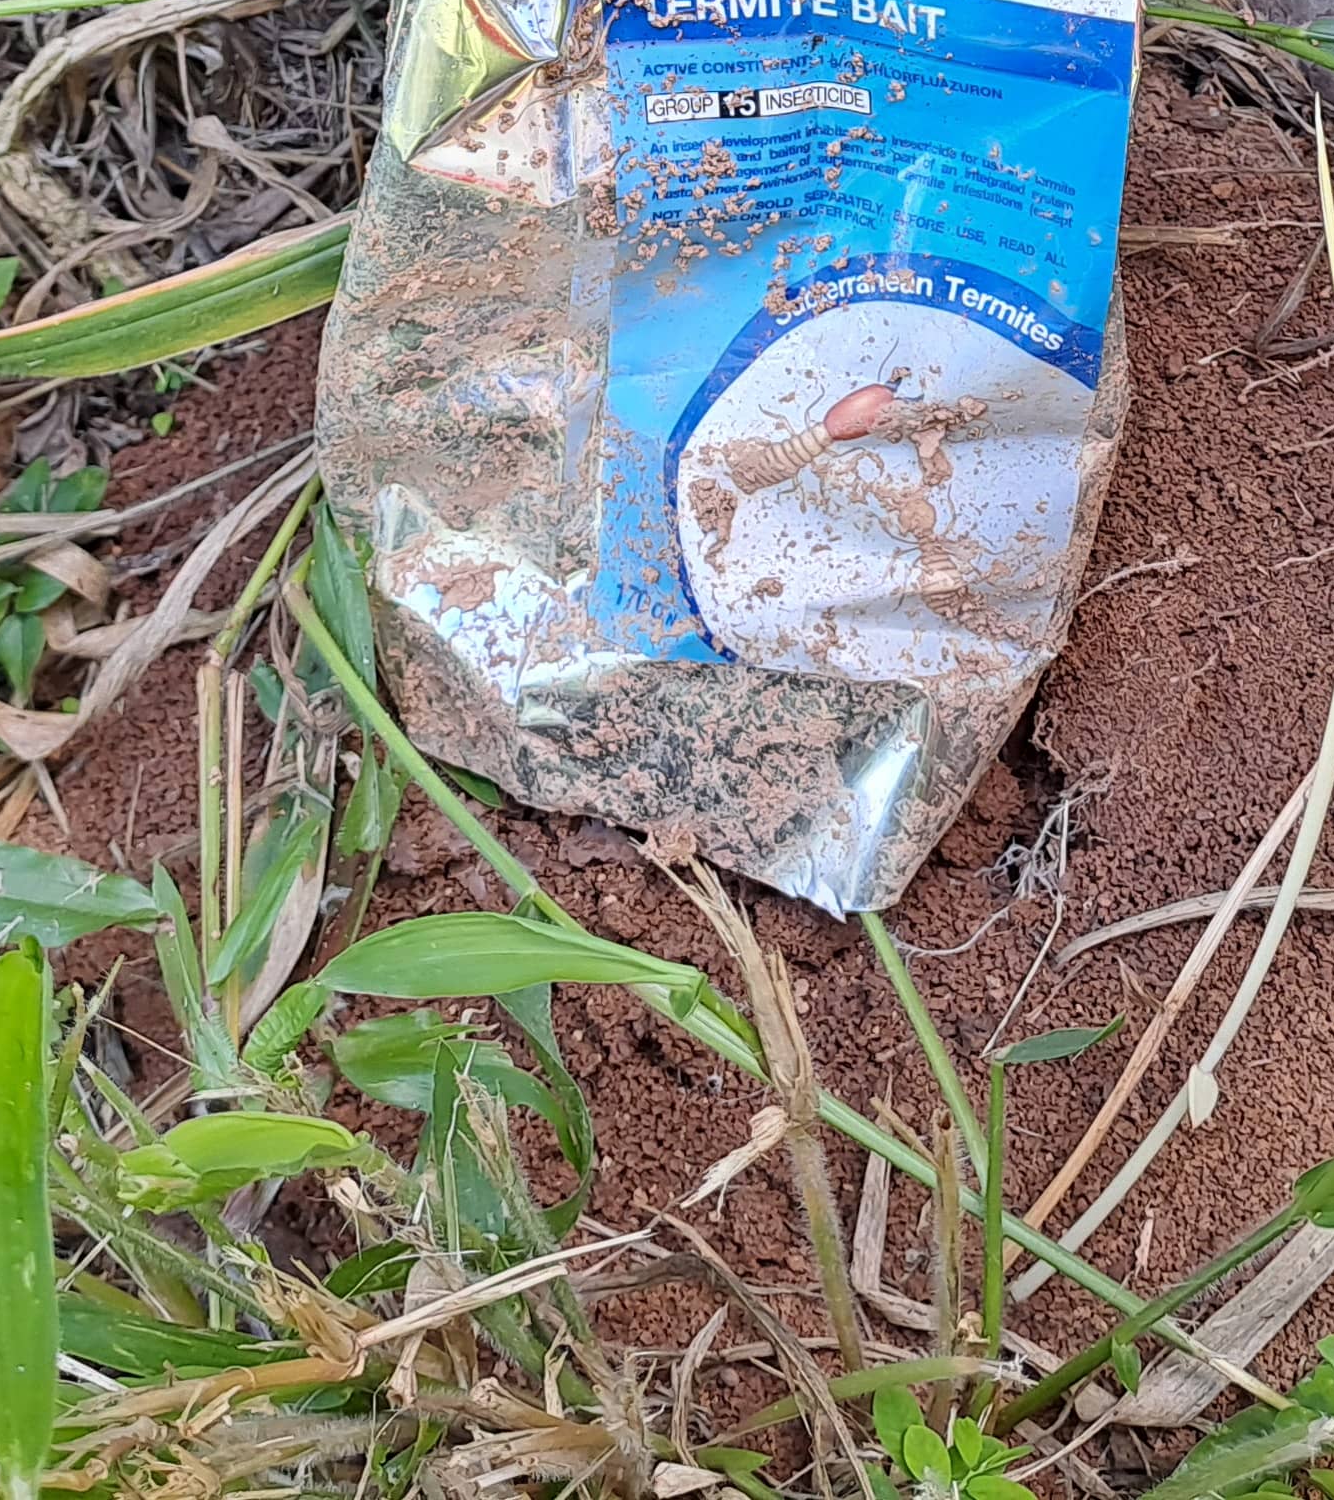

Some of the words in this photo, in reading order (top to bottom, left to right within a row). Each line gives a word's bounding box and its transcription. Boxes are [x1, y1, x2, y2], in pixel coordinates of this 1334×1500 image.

[643, 62, 698, 77] ACTIVE
[651, 94, 714, 117] GROUP
[722, 91, 757, 117] 15
[765, 86, 866, 111] INSECTICIDE
[817, 140, 864, 154] stem
[652, 208, 683, 221] NOT
[755, 196, 794, 211] SOLD
[998, 235, 1036, 257] READ
[1043, 250, 1068, 269] ALL
[943, 275, 1065, 351] Termites
